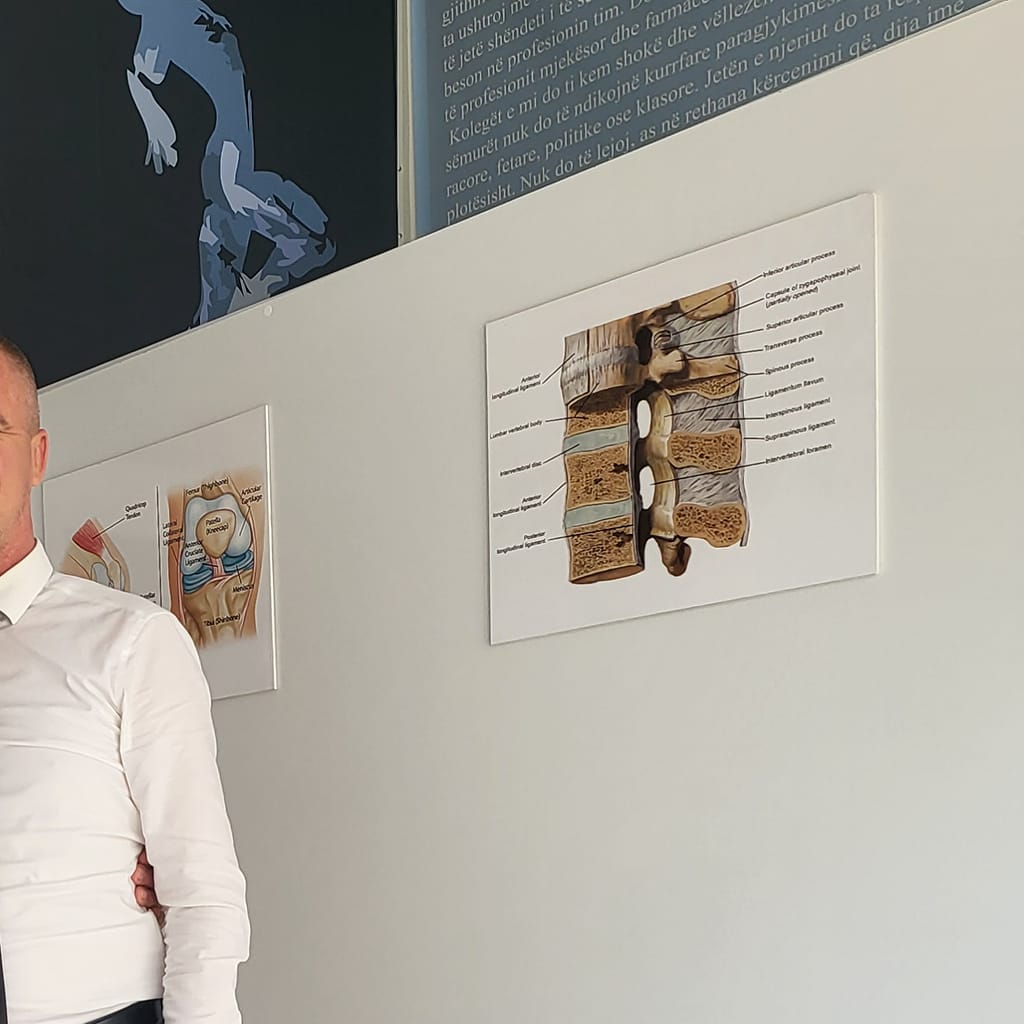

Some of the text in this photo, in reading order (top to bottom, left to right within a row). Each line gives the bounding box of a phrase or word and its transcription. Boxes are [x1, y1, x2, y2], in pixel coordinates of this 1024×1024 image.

[443, 33, 455, 47] ta
[459, 3, 505, 39] ushtroj
[444, 55, 456, 72] të
[458, 41, 484, 70] jetë
[487, 8, 545, 51] shëndeti
[550, 4, 554, 20] i
[444, 70, 482, 97] beson
[487, 57, 504, 77] në
[508, 18, 589, 72] profesionin
[594, 5, 624, 26] tim.
[445, 0, 709, 122] të profesionit mjekësor dhe farmac
[449, 110, 502, 146] Kolegët
[506, 106, 515, 119] e
[519, 92, 537, 115] mi
[543, 86, 560, 104] do
[579, 62, 611, 88] kem
[616, 36, 663, 71] shokë
[667, 25, 697, 48] dhe
[545, 121, 601, 160] politike
[606, 108, 632, 129] ose
[636, 81, 699, 117] klasore.
[704, 58, 748, 89] Jetën
[754, 52, 764, 66] e
[769, 23, 828, 62] njeriut
[834, 12, 857, 32] do
[864, 3, 881, 21] ta
[446, 137, 499, 173] sëmurët
[503, 124, 529, 148] nuk
[534, 116, 552, 134] do
[557, 105, 570, 124] të
[574, 74, 640, 117] ndikojnë
[644, 47, 711, 85] kurrfare
[447, 183, 516, 226] plotësisht.
[520, 166, 551, 191] Nuk
[555, 159, 574, 177] do
[578, 148, 593, 167] të
[640, 126, 656, 142] as
[661, 111, 680, 133] në
[685, 87, 747, 123] rethana
[883, 16, 920, 42] dija
[927, 0, 965, 25] ime
